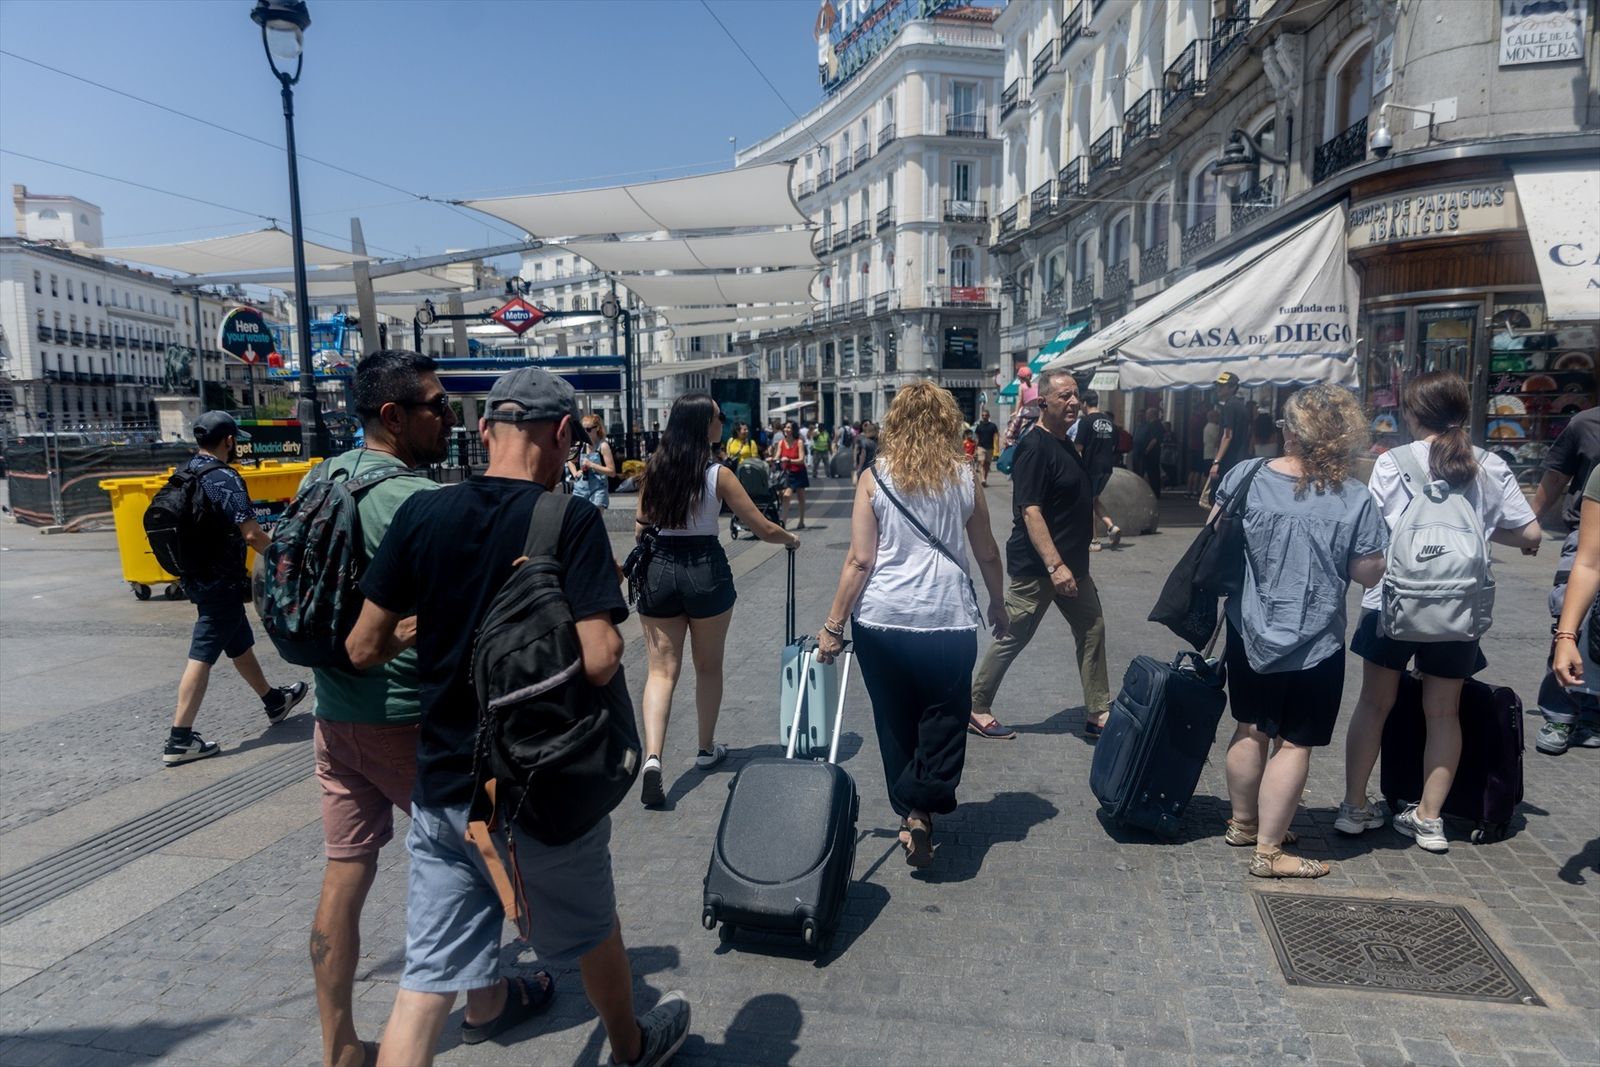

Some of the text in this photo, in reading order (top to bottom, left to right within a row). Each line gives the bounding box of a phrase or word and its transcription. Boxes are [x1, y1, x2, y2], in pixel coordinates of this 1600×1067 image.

[1507, 32, 1547, 46] CALLE
[1549, 32, 1561, 41] DE
[1505, 42, 1579, 61] MONTERA
[1392, 198, 1411, 219] DE
[1416, 186, 1505, 216] PARAGUAS
[1369, 209, 1460, 242] ABANICOS
[505, 311, 529, 320] Metro
[1279, 303, 1323, 315] fundada
[235, 319, 259, 333] Here
[226, 333, 270, 345] your waste
[1167, 327, 1241, 349] CASA
[1248, 334, 1268, 345] DE
[1274, 322, 1352, 344] DIEGO
[235, 440, 301, 457] get Madrid dirty
[1421, 545, 1446, 554] NIKE
